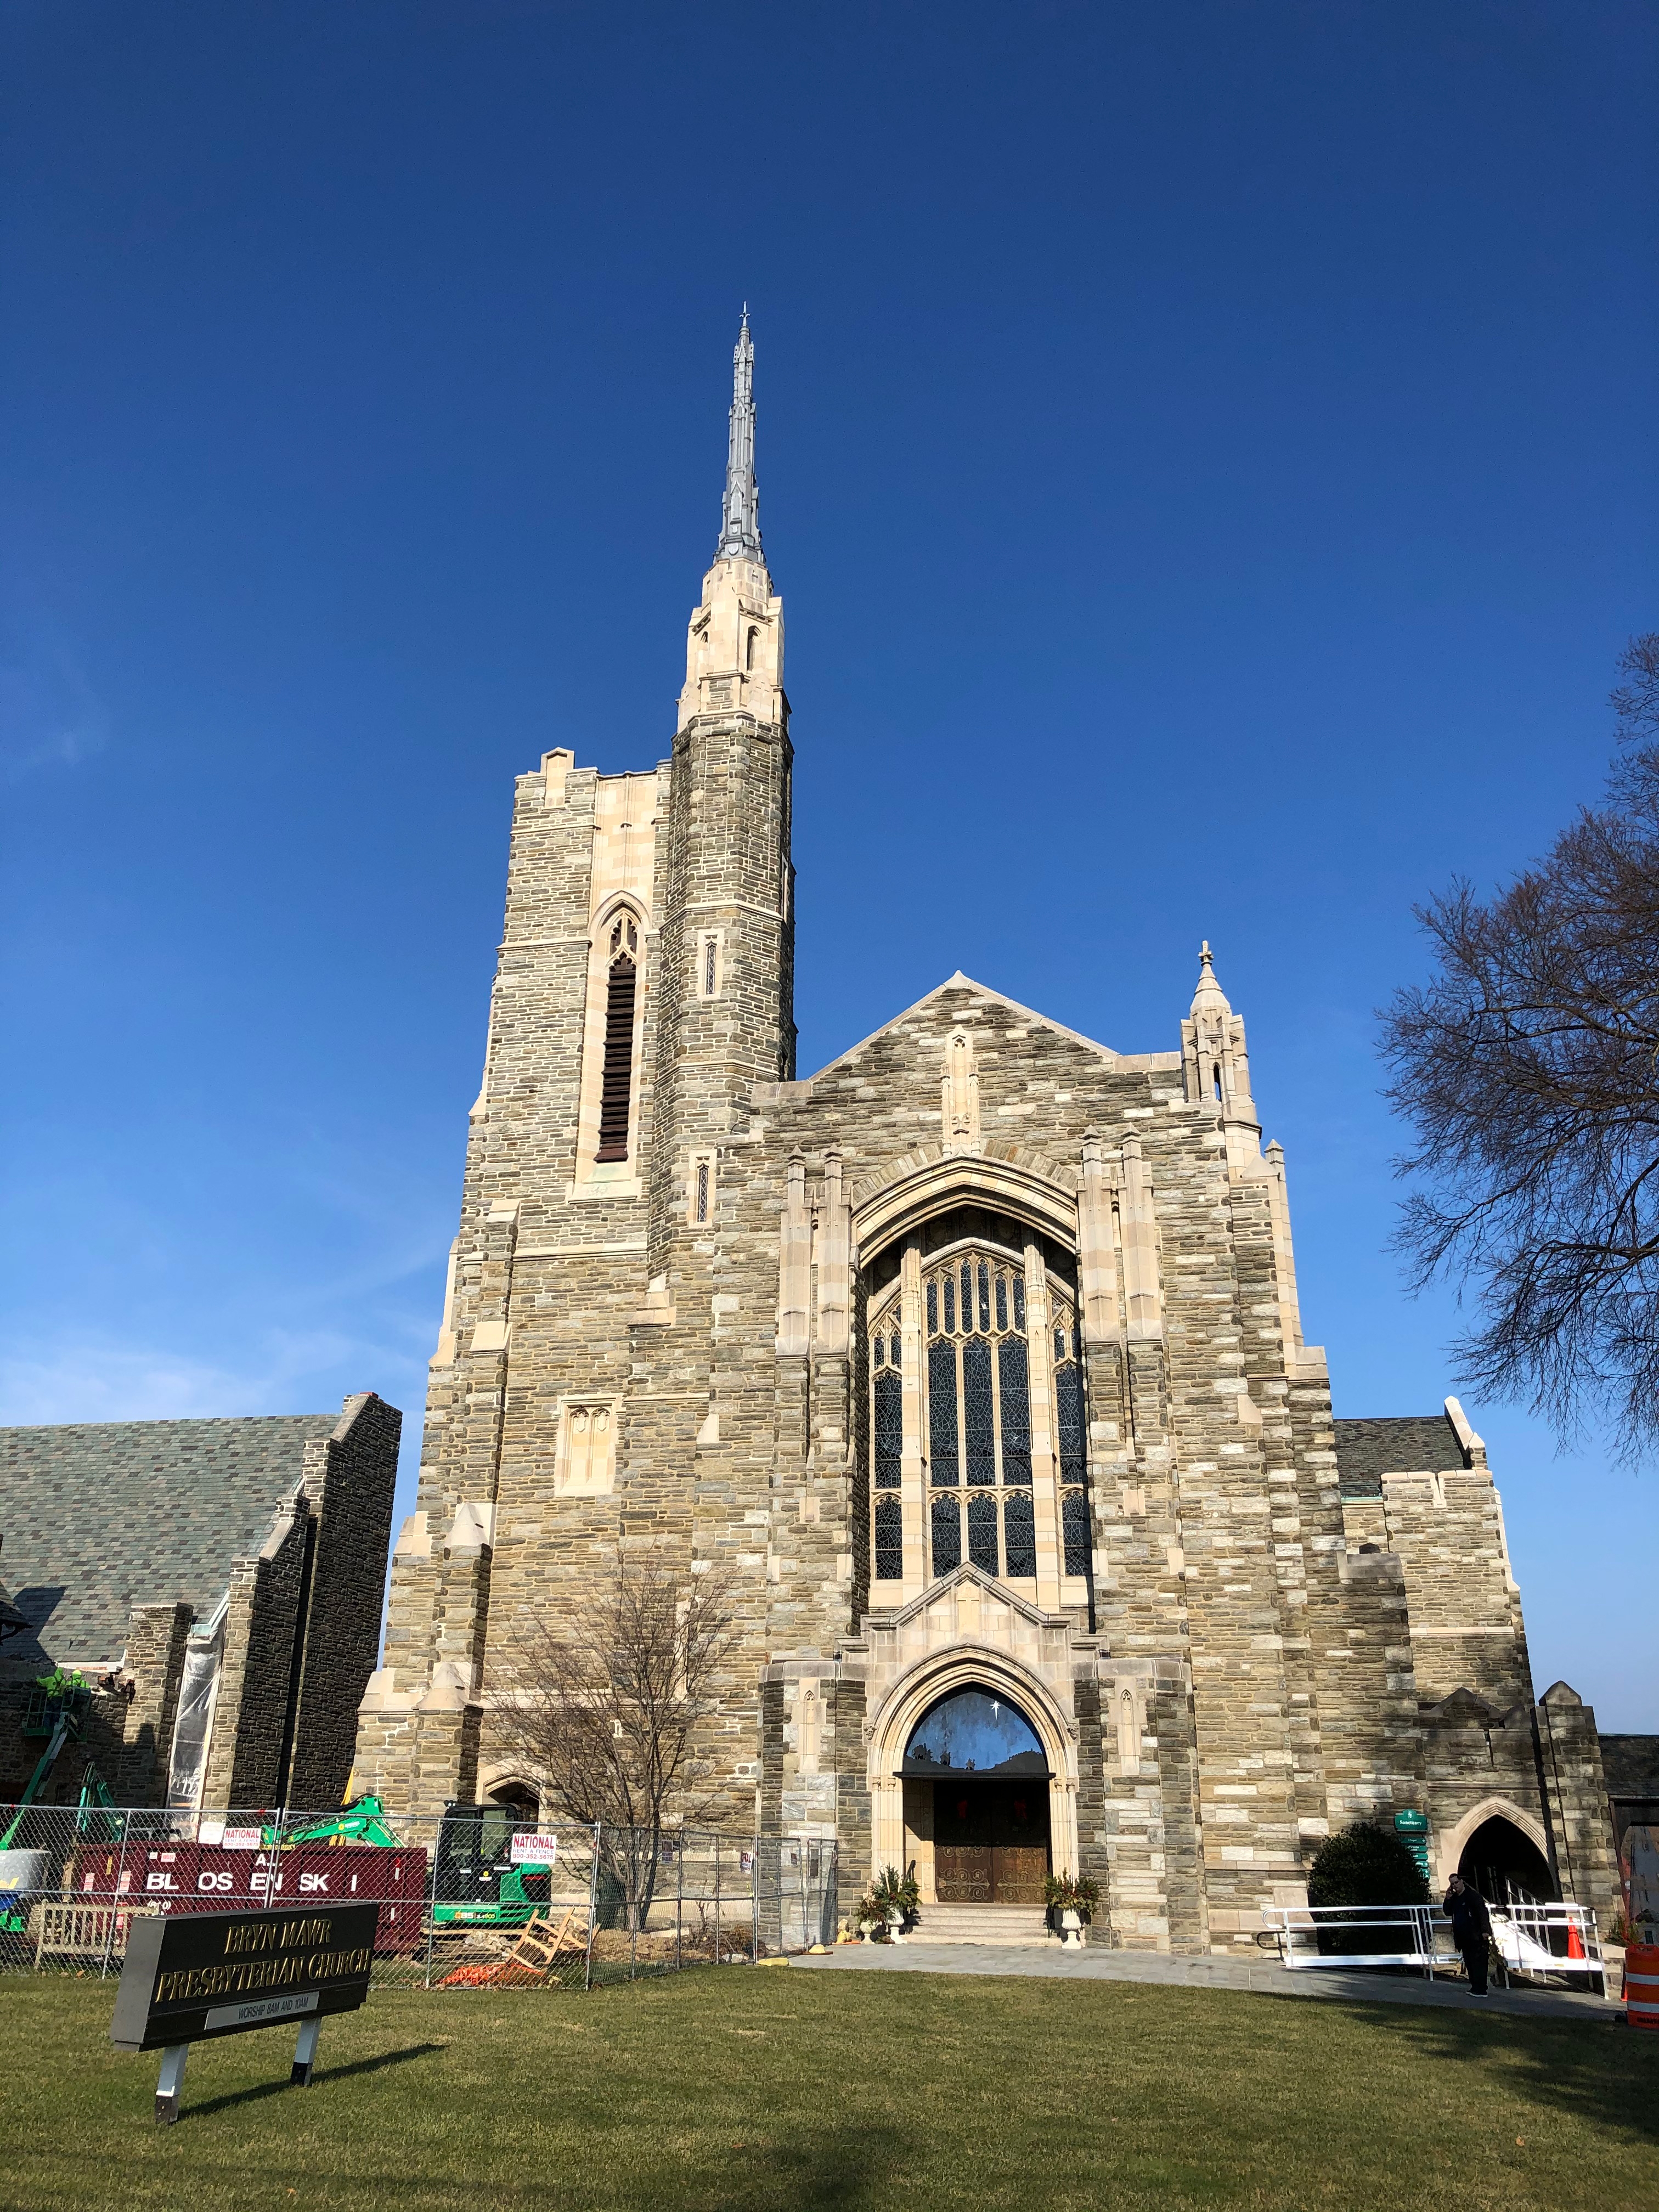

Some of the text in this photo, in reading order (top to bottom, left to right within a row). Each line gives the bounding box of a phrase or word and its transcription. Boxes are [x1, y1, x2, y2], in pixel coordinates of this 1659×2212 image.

[225, 1829, 259, 1838] NATIONAL
[514, 1836, 554, 1849] NATIONAL
[224, 1919, 332, 1954] BRYN MAWR
[155, 1948, 371, 2003] PRESBYTERIAN CHURCH
[238, 1997, 308, 2019] WORSHIP 8AM AND 10AM
